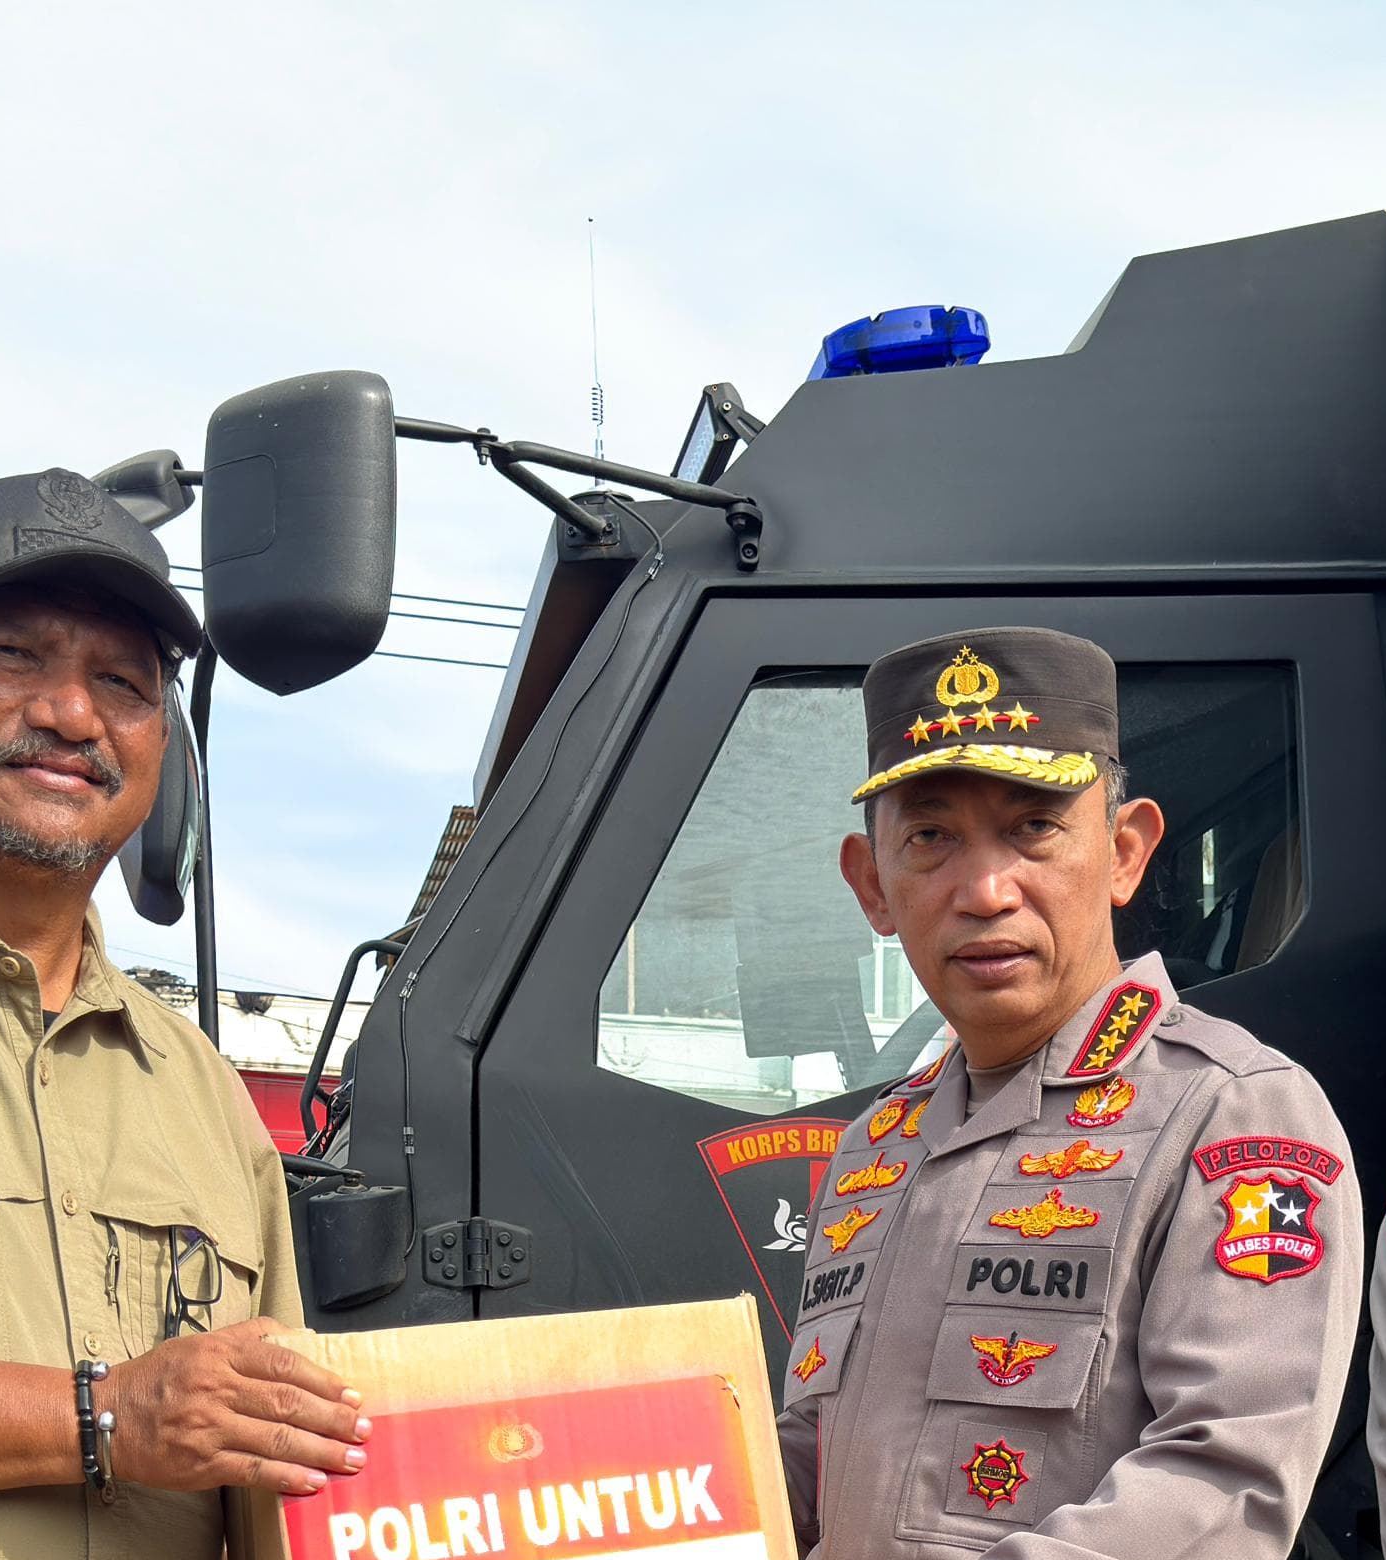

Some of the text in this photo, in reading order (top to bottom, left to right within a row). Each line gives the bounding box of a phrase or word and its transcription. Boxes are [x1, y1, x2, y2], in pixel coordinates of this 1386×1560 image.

[726, 1129, 801, 1165] KORPS
[1209, 1141, 1331, 1174] PELOPOR
[1223, 1236, 1316, 1259] MABES POLRI
[966, 1257, 1089, 1299] POLRI
[518, 1463, 723, 1547] UNTUK
